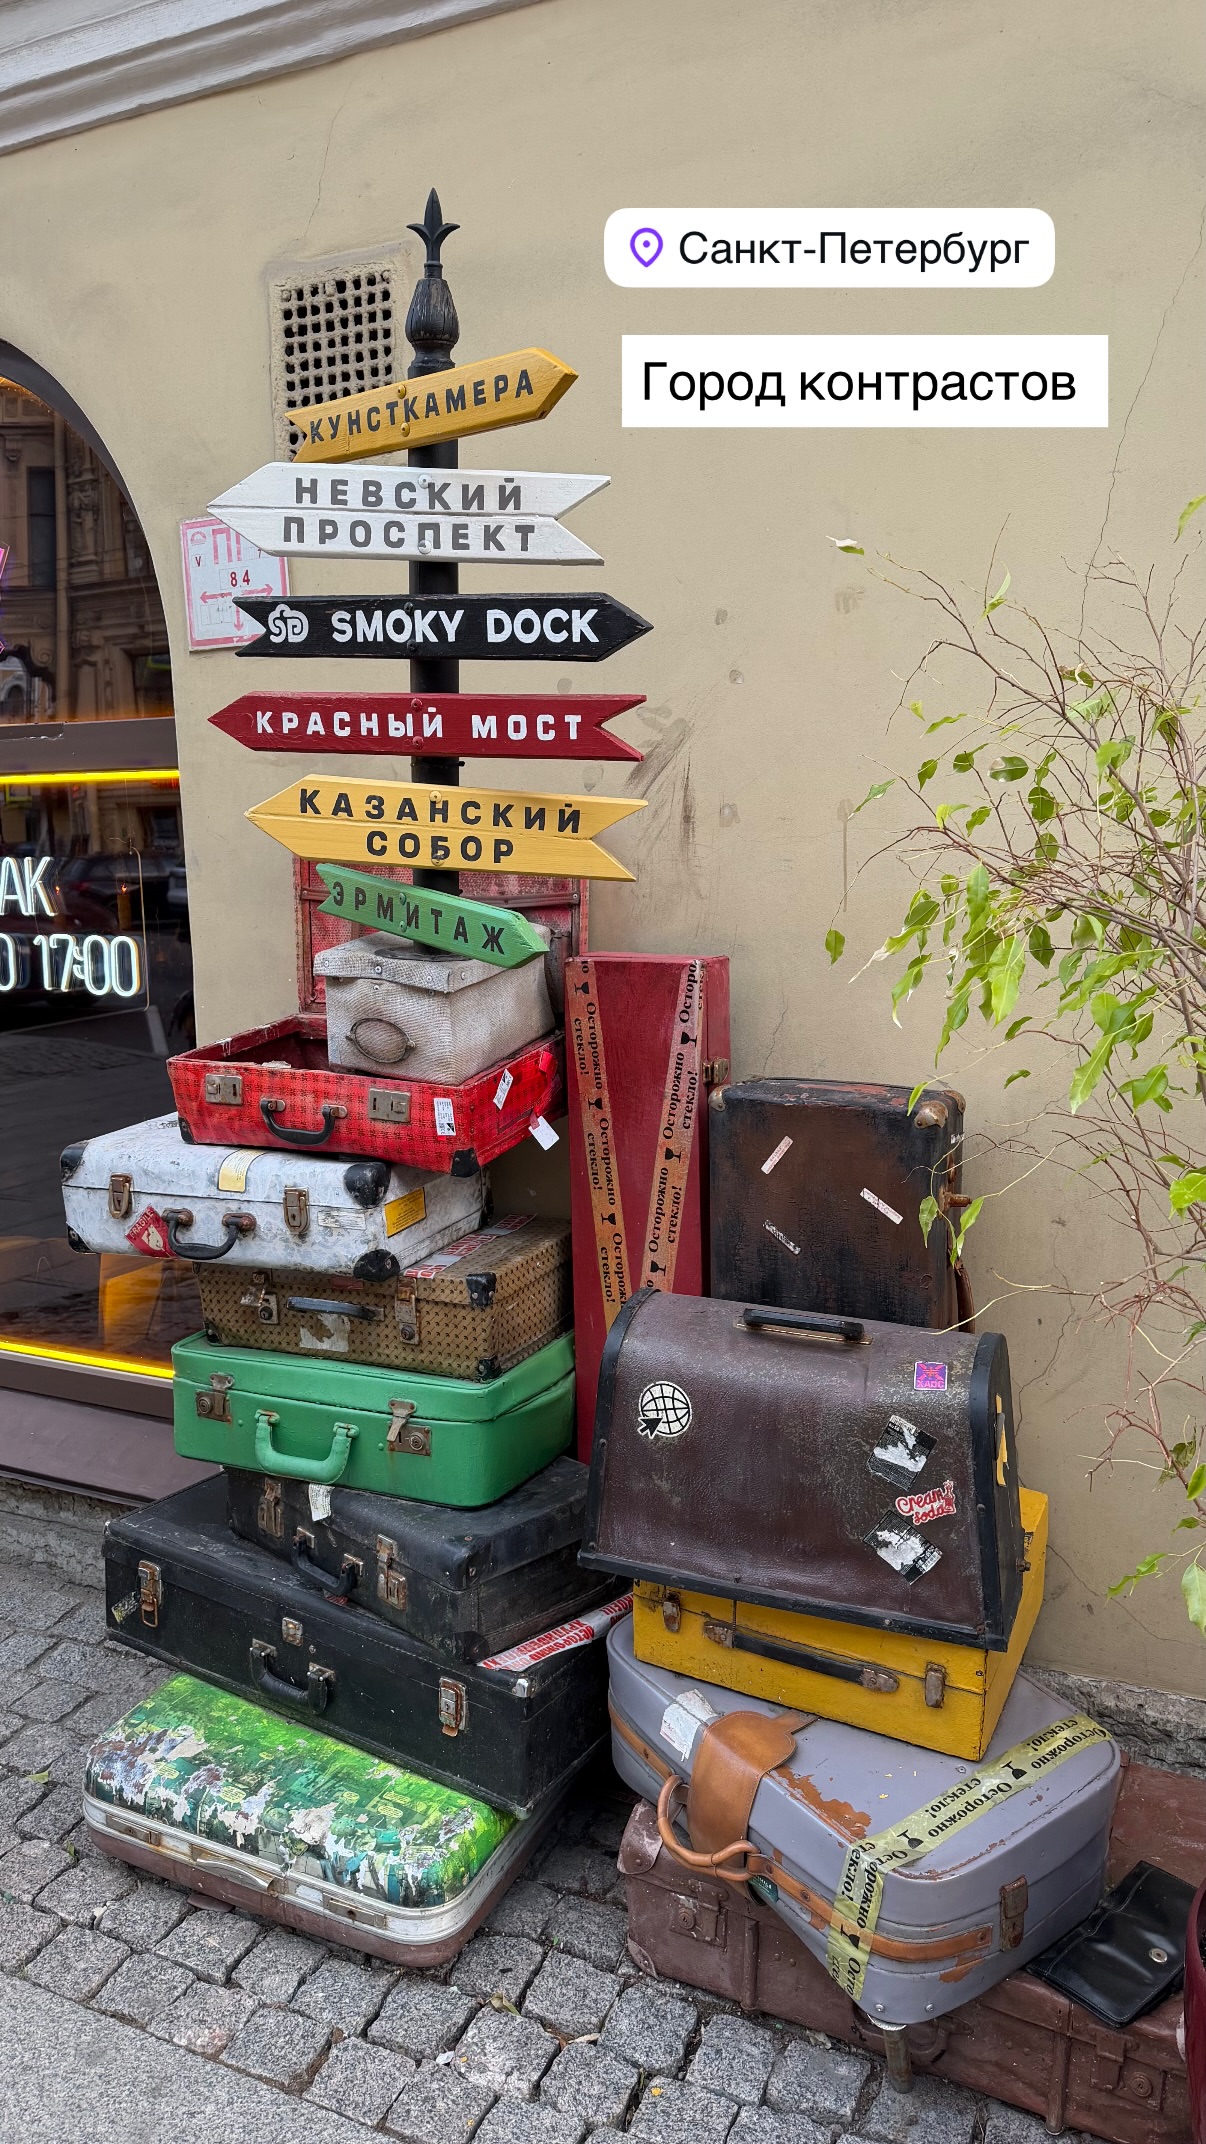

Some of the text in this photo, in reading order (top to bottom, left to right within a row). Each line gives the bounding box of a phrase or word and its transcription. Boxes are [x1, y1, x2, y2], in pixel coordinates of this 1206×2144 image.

[309, 368, 534, 445] КУНСТКАМЕРА
[295, 477, 522, 511] НЕВСКИЙ
[283, 516, 536, 552] ПРОСПЕКТ
[331, 609, 465, 643] SMOKY
[486, 609, 600, 643] DOCK
[256, 706, 583, 741] КРАСНЫЙ МОСТ
[299, 788, 582, 834] КАЗАНСКИЙ
[366, 830, 515, 864] СОБОР
[331, 880, 506, 956] ЭРМИТАЖ
[33, 933, 141, 997] 17:00
[574, 1017, 590, 1076] стекло!
[586, 1002, 603, 1090] Осторожно
[662, 1052, 685, 1140] Осторожно
[682, 1070, 698, 1130] стекло!
[587, 1132, 603, 1191] стекло!
[600, 1117, 616, 1206] Осторожно
[129, 1209, 154, 1239] FRAGILE
[648, 1167, 669, 1253] Осторожно
[667, 1185, 682, 1244] стекло!
[600, 1246, 616, 1303] стекло!
[896, 1488, 944, 1514] Cream
[913, 1504, 945, 1525] soda
[1026, 1719, 1078, 1752] стекло!
[1031, 1727, 1107, 1770] Осторожно
[925, 1777, 981, 1819] стекло!
[928, 1781, 1013, 1838] Осторожно
[841, 1841, 876, 1902] стекло!
[856, 1848, 908, 1930] Осторожно
